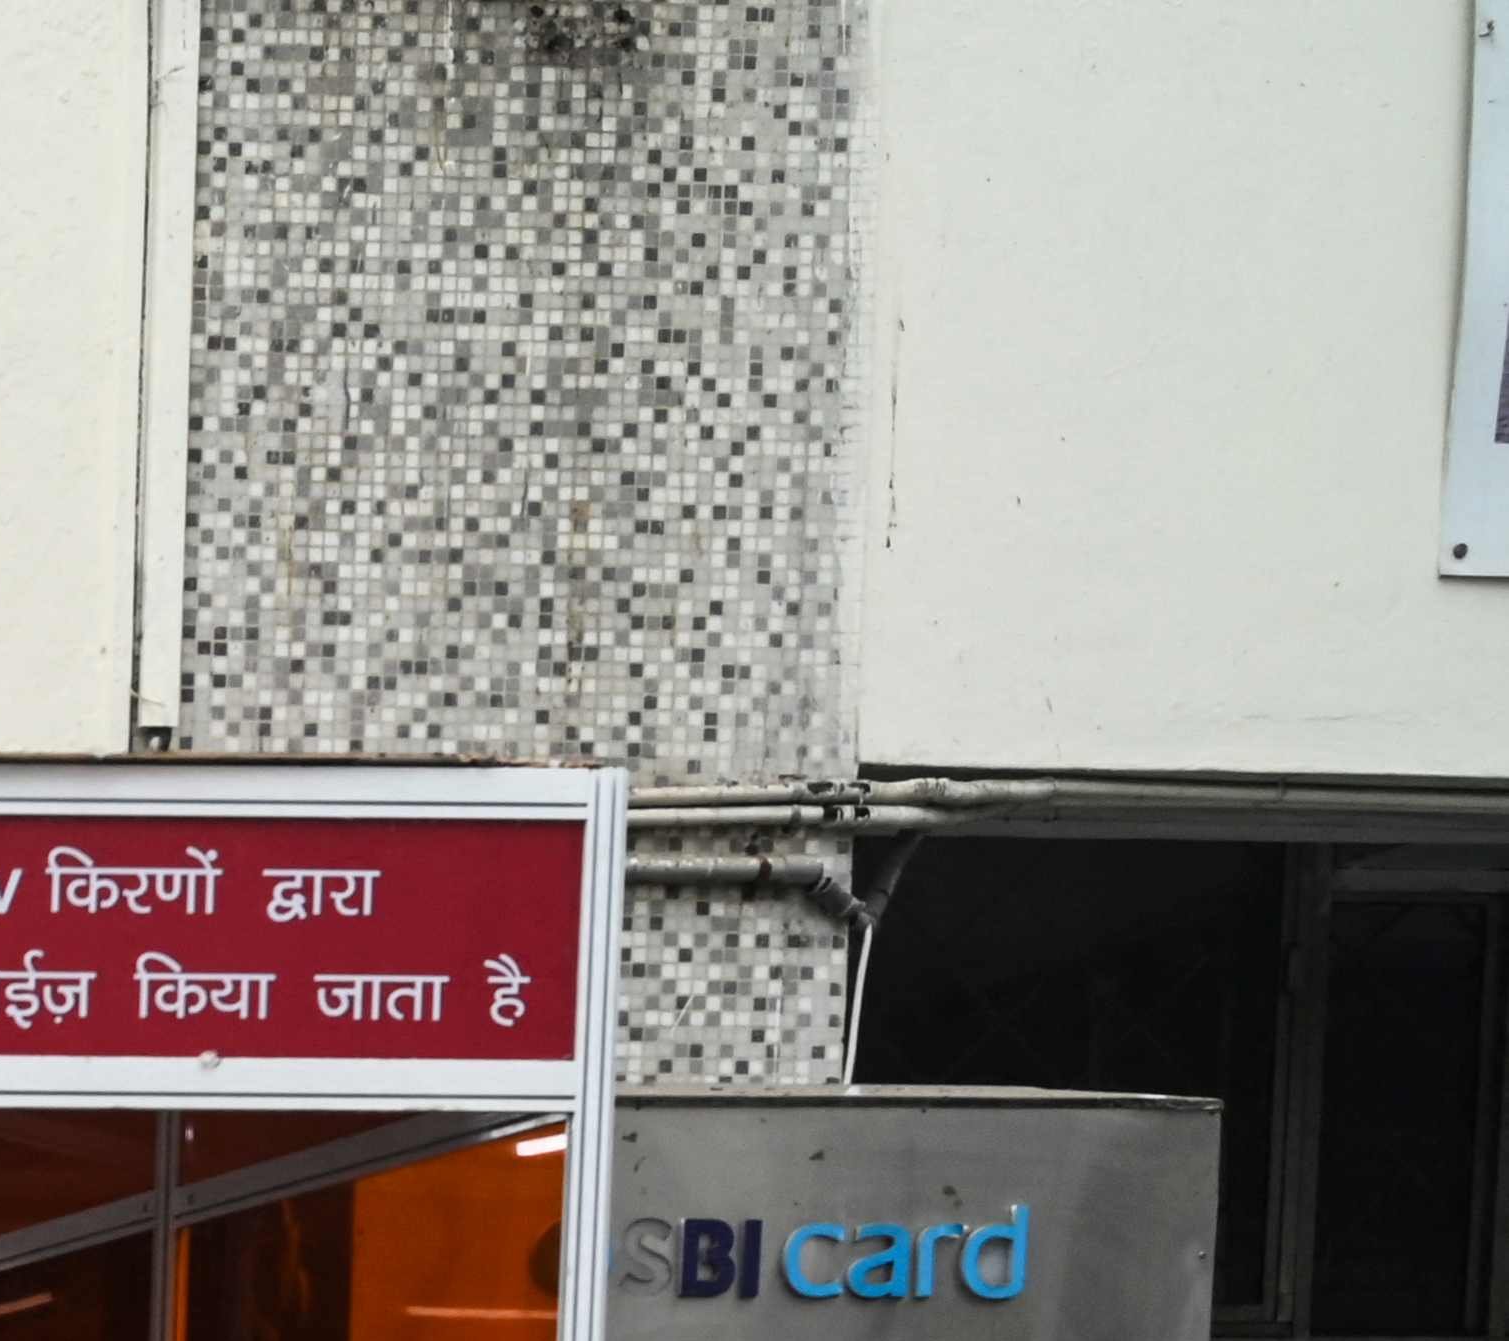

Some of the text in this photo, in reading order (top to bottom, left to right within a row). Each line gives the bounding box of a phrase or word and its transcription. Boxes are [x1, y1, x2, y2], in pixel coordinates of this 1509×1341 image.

[46, 847, 224, 917] किरणों
[262, 867, 382, 924] द्वारा
[133, 950, 276, 1022] किया
[313, 972, 450, 1023] जाता
[483, 954, 532, 1028] है
[619, 1204, 1031, 1302] SBI card
